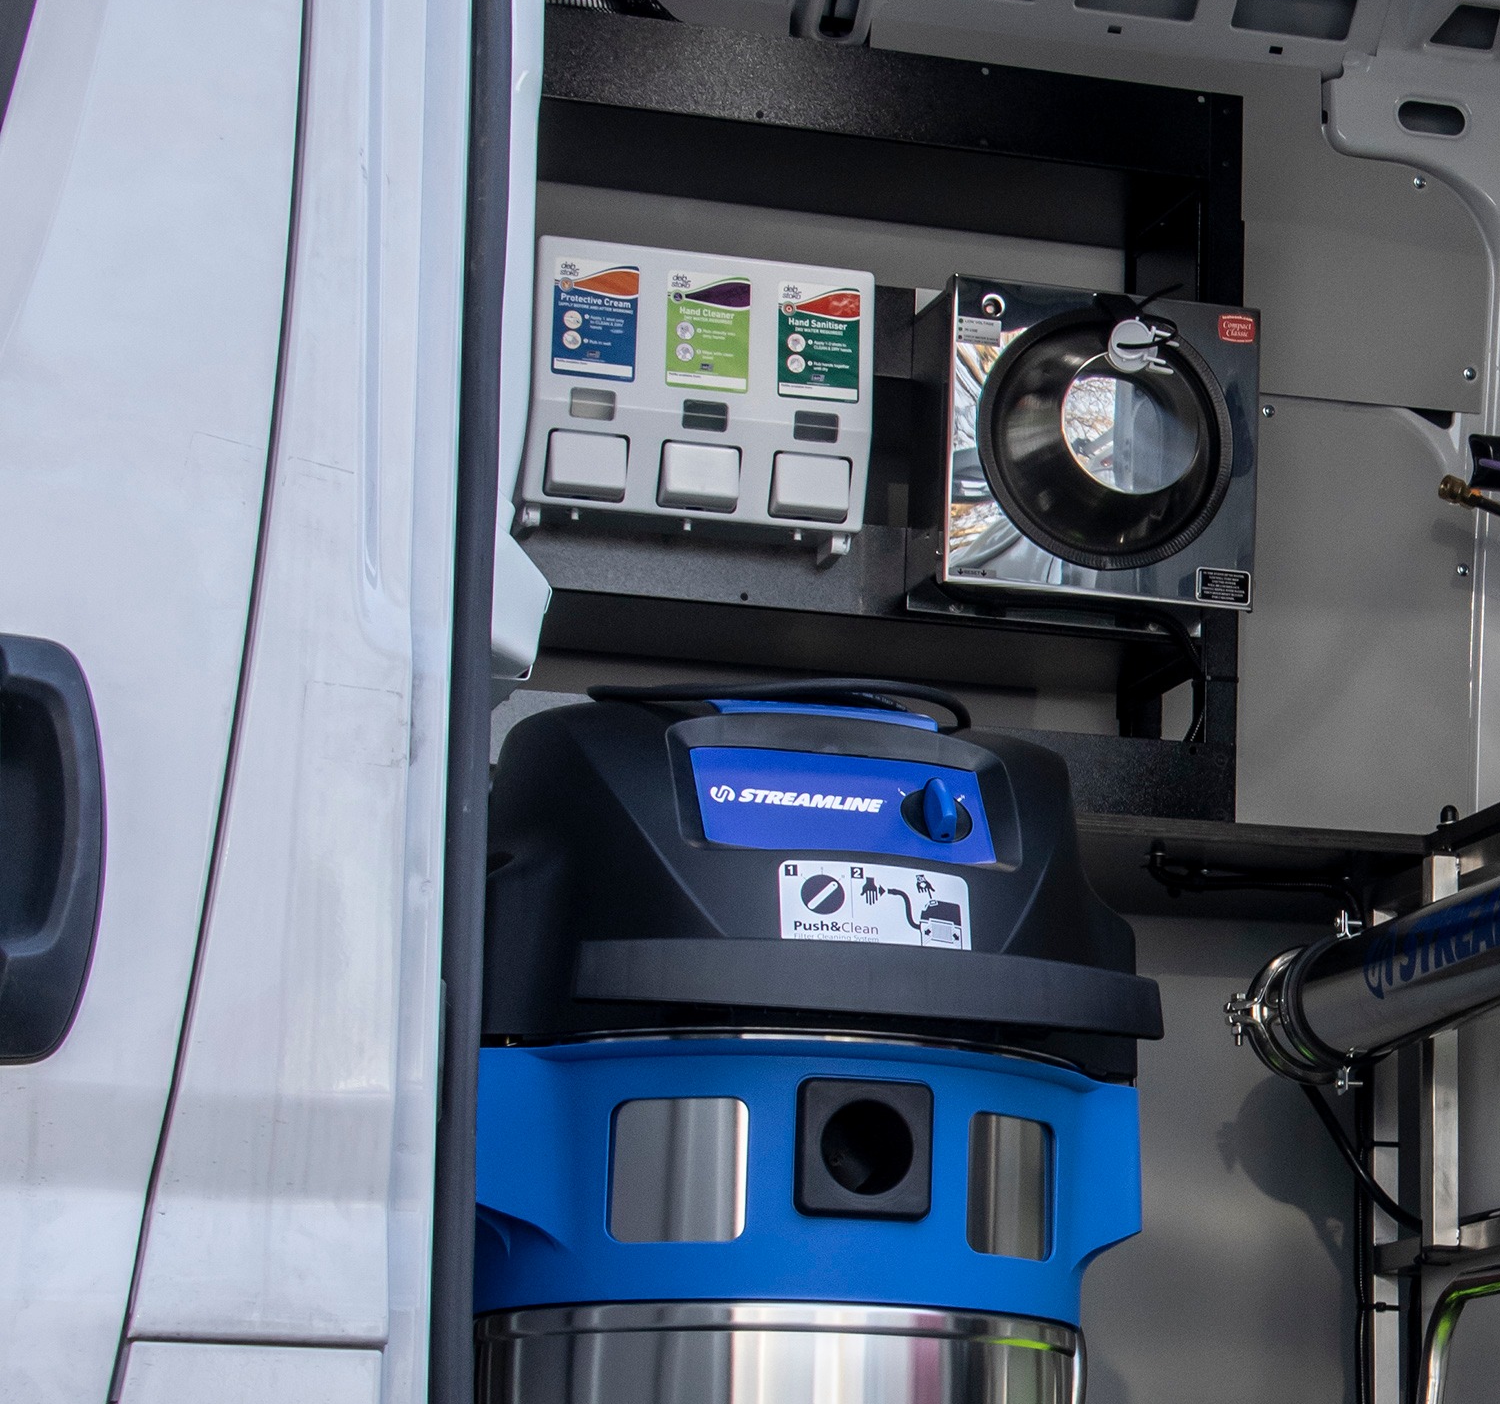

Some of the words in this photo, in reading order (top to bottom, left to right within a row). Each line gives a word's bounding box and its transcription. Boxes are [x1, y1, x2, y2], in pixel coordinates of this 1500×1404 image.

[561, 293, 602, 305] Protective
[604, 298, 632, 308] Cream
[680, 306, 700, 315] Hand
[703, 309, 734, 319] Cleaner
[788, 317, 809, 326] Hand
[811, 319, 847, 330] Sanitiser
[1223, 320, 1252, 331] Compact
[1226, 329, 1249, 337] Classic
[738, 788, 884, 813] STREAMLINE
[794, 920, 879, 935] Push&Clean
